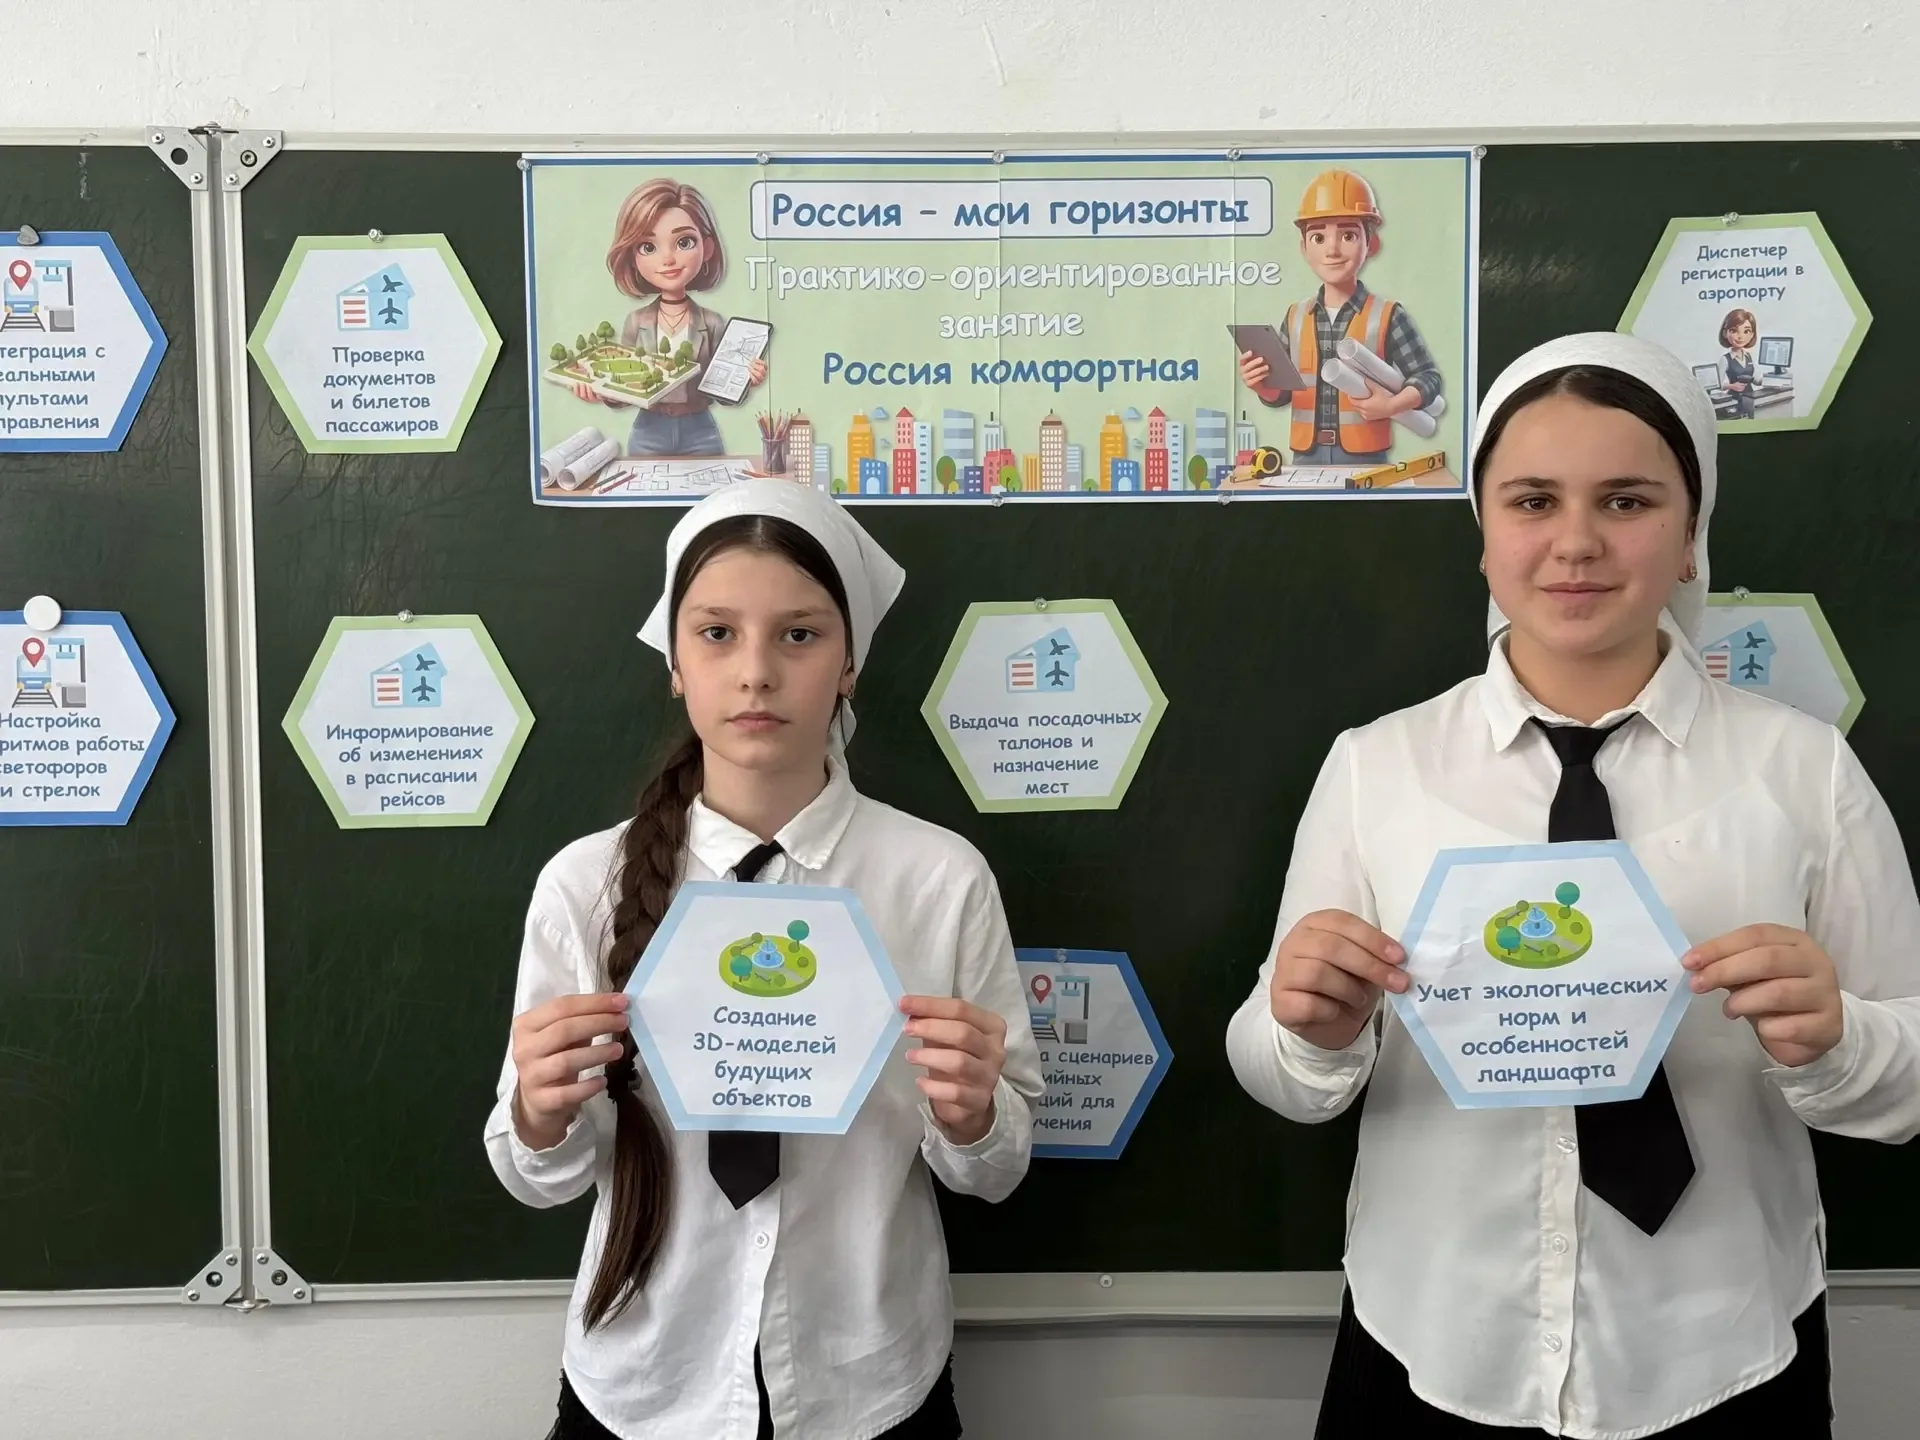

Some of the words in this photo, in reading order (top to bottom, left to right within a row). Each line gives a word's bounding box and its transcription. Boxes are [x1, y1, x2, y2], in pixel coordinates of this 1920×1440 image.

[772, 193, 902, 227] Россия
[953, 202, 1030, 227] мои
[1049, 199, 1250, 233] горизонты
[1697, 244, 1788, 262] Диспетчер
[744, 255, 1283, 298] Практико-ориентированное
[1681, 264, 1788, 284] регистрации
[1795, 265, 1804, 275] в
[1698, 285, 1786, 303] аэропорту
[939, 311, 1085, 339] занятие
[0, 345, 87, 363] теграция
[95, 346, 106, 358] с
[332, 347, 425, 366] Проверка
[0, 370, 95, 382] альными
[323, 373, 436, 390] документов
[823, 352, 952, 385] Россия
[970, 356, 1200, 393] комфортная
[330, 398, 344, 410] и
[352, 394, 431, 409] билетов
[0, 417, 100, 434] правления
[325, 418, 439, 436] пассажиров
[0, 712, 101, 732] Настройка
[949, 713, 1019, 730] Выдача
[1028, 711, 1142, 728] посадочных
[326, 724, 494, 743] Информирование
[0, 739, 70, 755] ритмов
[76, 736, 145, 755] работы
[998, 737, 1073, 751] талонов
[1081, 736, 1094, 748] и
[338, 747, 361, 762] об
[370, 747, 483, 761] изменениях
[0, 762, 108, 778] ветофоров
[993, 758, 1099, 773] назначение
[346, 774, 356, 785] в
[364, 770, 477, 789] расписании
[1025, 782, 1070, 794] мест
[0, 786, 13, 797] и
[22, 785, 101, 801] стрелок
[380, 791, 446, 811] рейсов
[1416, 983, 1473, 1003] Учет
[1483, 978, 1668, 1001] экологических
[713, 1006, 817, 1027] Создание
[1498, 1012, 1560, 1030] норм
[1571, 1010, 1587, 1024] и
[693, 1032, 836, 1055] 3D-моделей
[1461, 1030, 1629, 1056] особенностей
[1058, 1051, 1154, 1068] сценариев
[714, 1060, 813, 1084] будущих
[1042, 1069, 1102, 1086] ийных
[1477, 1064, 1616, 1085] ландшафта
[712, 1088, 812, 1108] объектов
[1081, 1096, 1115, 1110] для
[1033, 1117, 1092, 1130] чения
